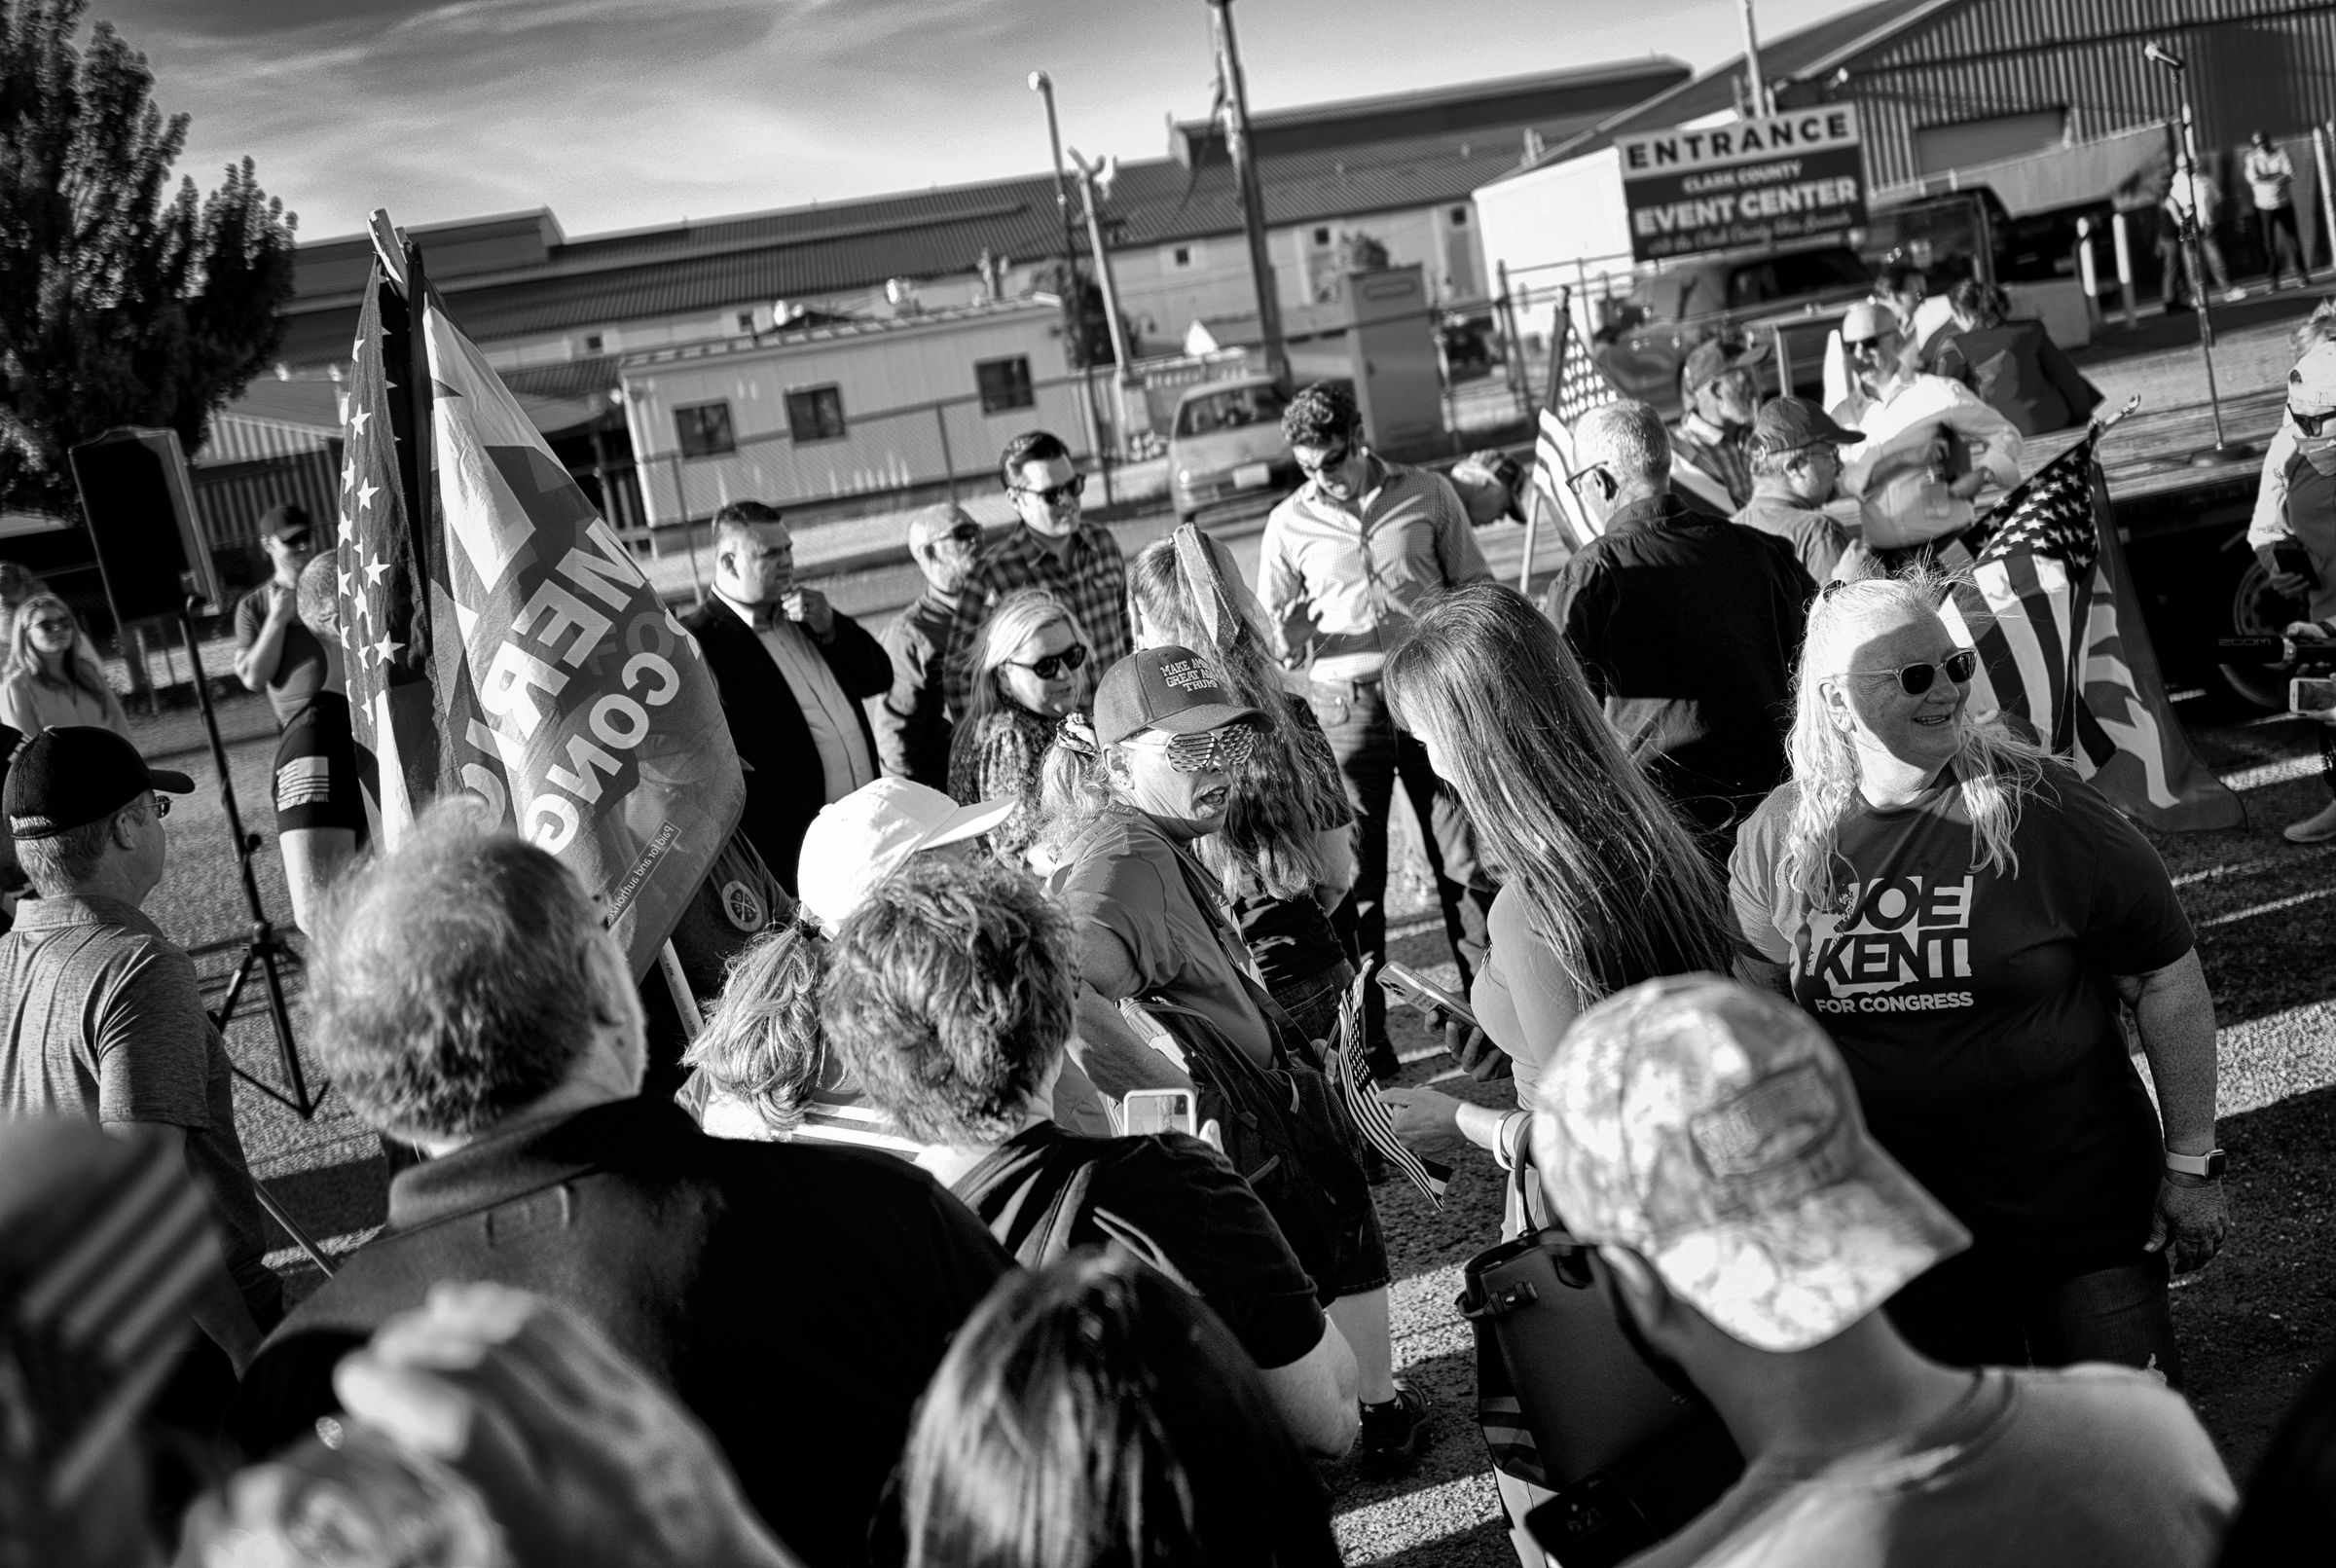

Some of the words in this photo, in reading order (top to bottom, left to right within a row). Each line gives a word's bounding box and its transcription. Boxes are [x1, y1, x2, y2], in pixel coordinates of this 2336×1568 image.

[1627, 112, 1849, 169] ENTRANCE
[1682, 168, 1735, 194] CLARK
[1736, 159, 1804, 185] COUNTY
[1633, 195, 1735, 236] EVENT
[1738, 175, 1858, 218] CENTER
[1160, 660, 1190, 676] MAKE
[1166, 670, 1200, 688] GREAT
[1834, 875, 1967, 932] JOE
[1813, 929, 1970, 986] KENT
[1814, 998, 1856, 1014] FOR
[1858, 991, 1975, 1013] CONGRESS
